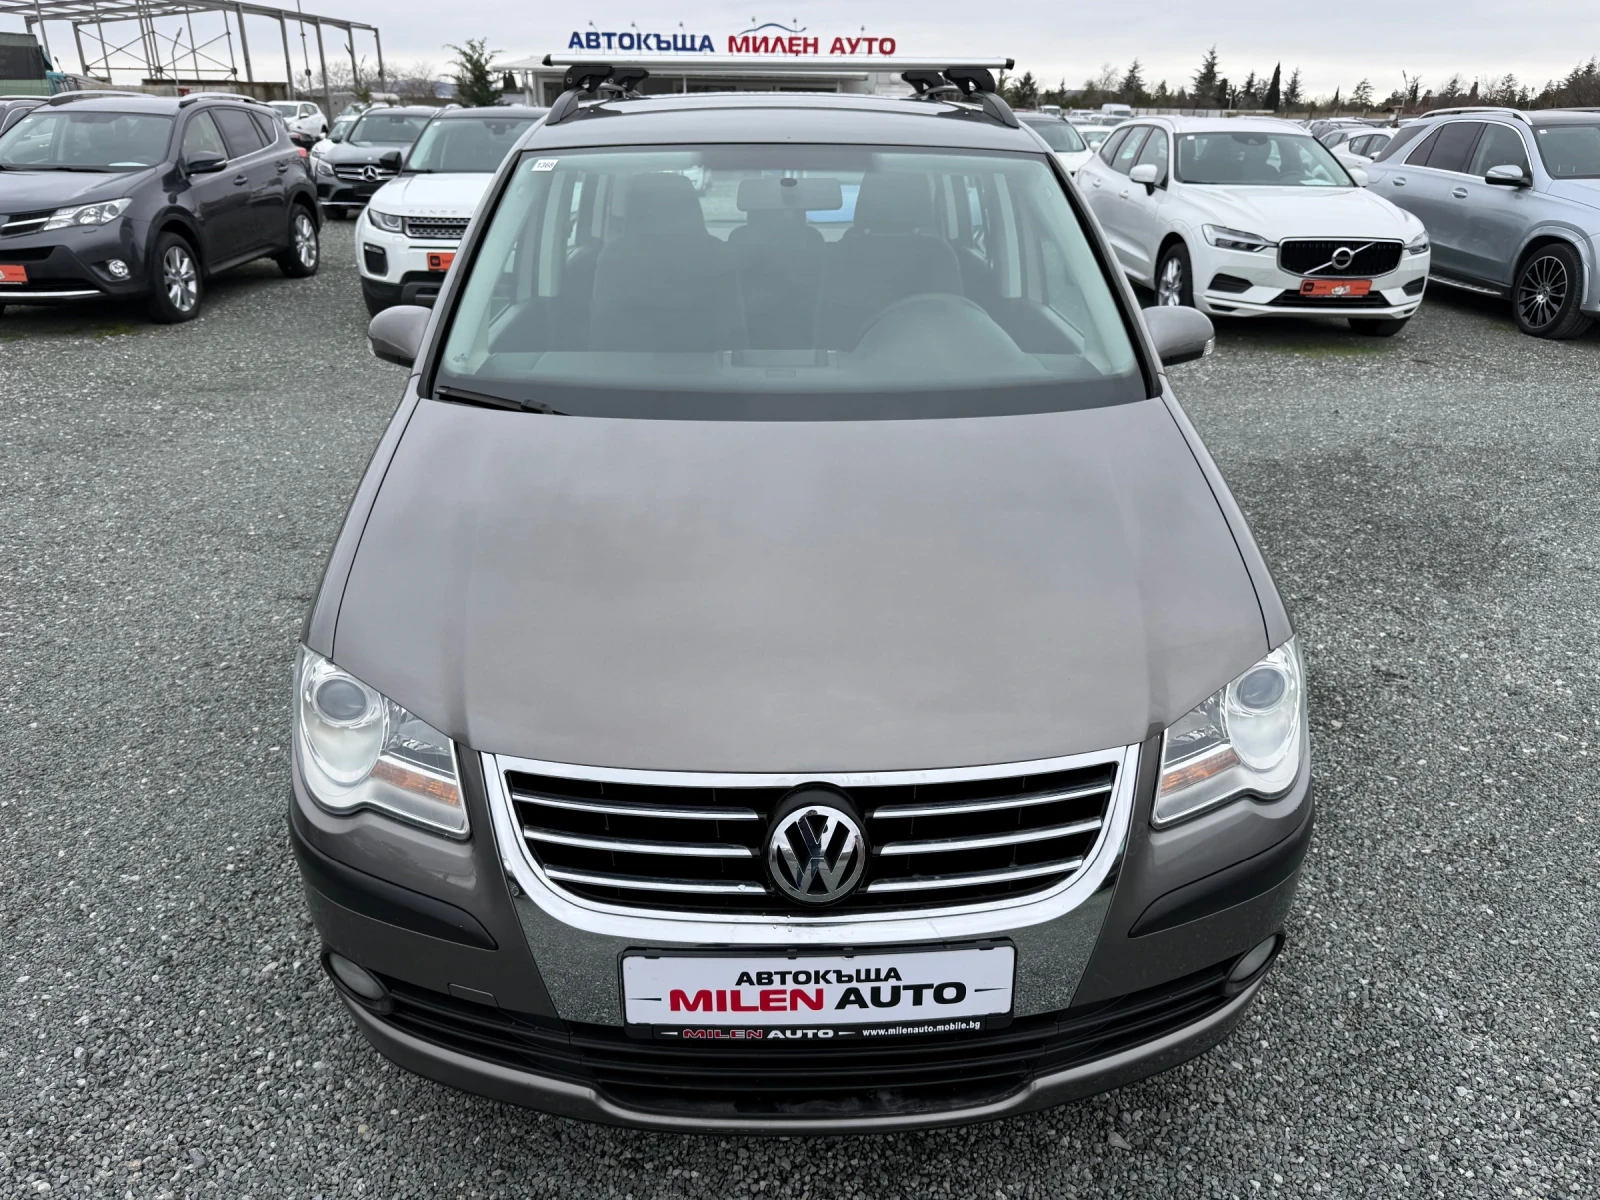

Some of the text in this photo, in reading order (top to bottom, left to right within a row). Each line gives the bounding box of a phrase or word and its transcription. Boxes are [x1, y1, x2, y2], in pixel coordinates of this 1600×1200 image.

[728, 35, 819, 55] МИЛЕН
[829, 37, 896, 55] АУТО
[669, 982, 967, 1012] MILEN AUTO
[683, 1020, 981, 1039] MILEN AUTO www.milenauto.mobile.bg
